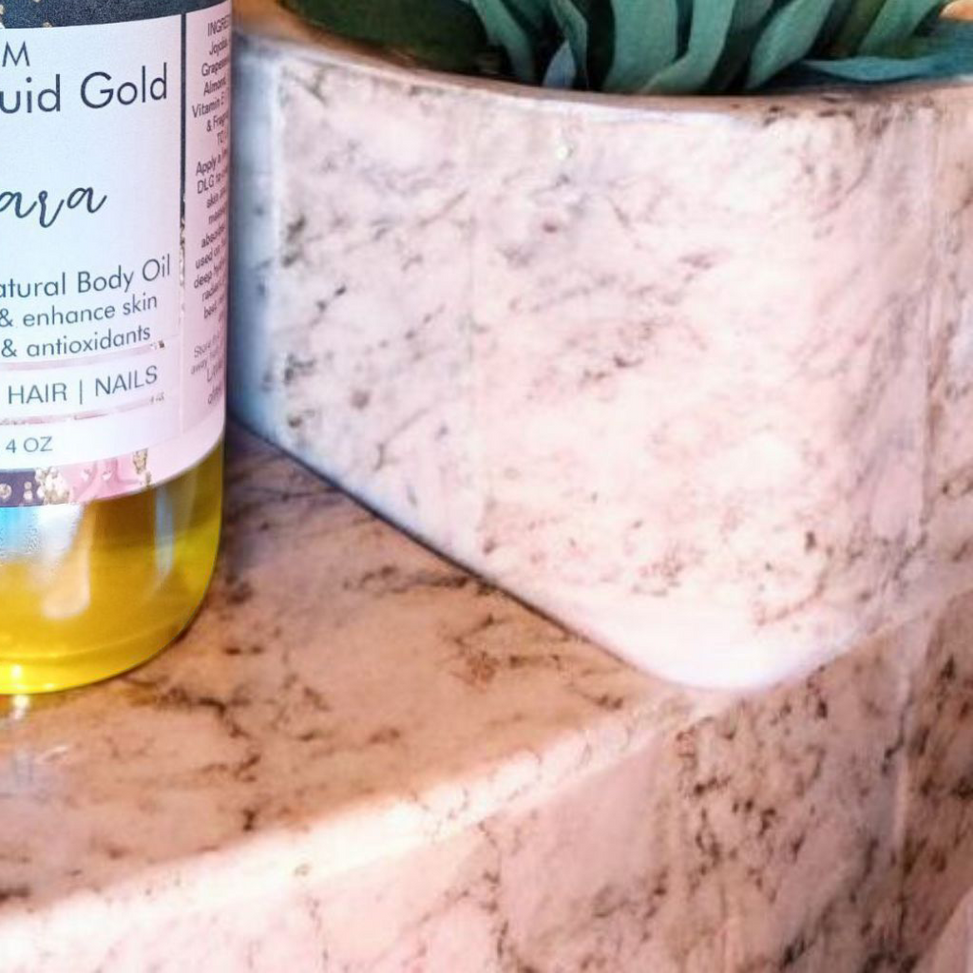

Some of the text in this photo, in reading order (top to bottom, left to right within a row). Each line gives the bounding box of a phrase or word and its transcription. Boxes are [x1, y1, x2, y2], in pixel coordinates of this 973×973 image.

[80, 63, 168, 110] Gold
[195, 155, 217, 176] Apply
[78, 266, 134, 293] Body
[142, 253, 170, 282] Oil
[23, 305, 116, 328] enhance
[123, 294, 157, 316] skin
[1, 339, 17, 358] &
[27, 325, 151, 358] antioxidants
[8, 382, 67, 404] HAIR
[95, 365, 158, 398] NAILS
[6, 439, 17, 453] 4
[23, 436, 53, 452] OZ
